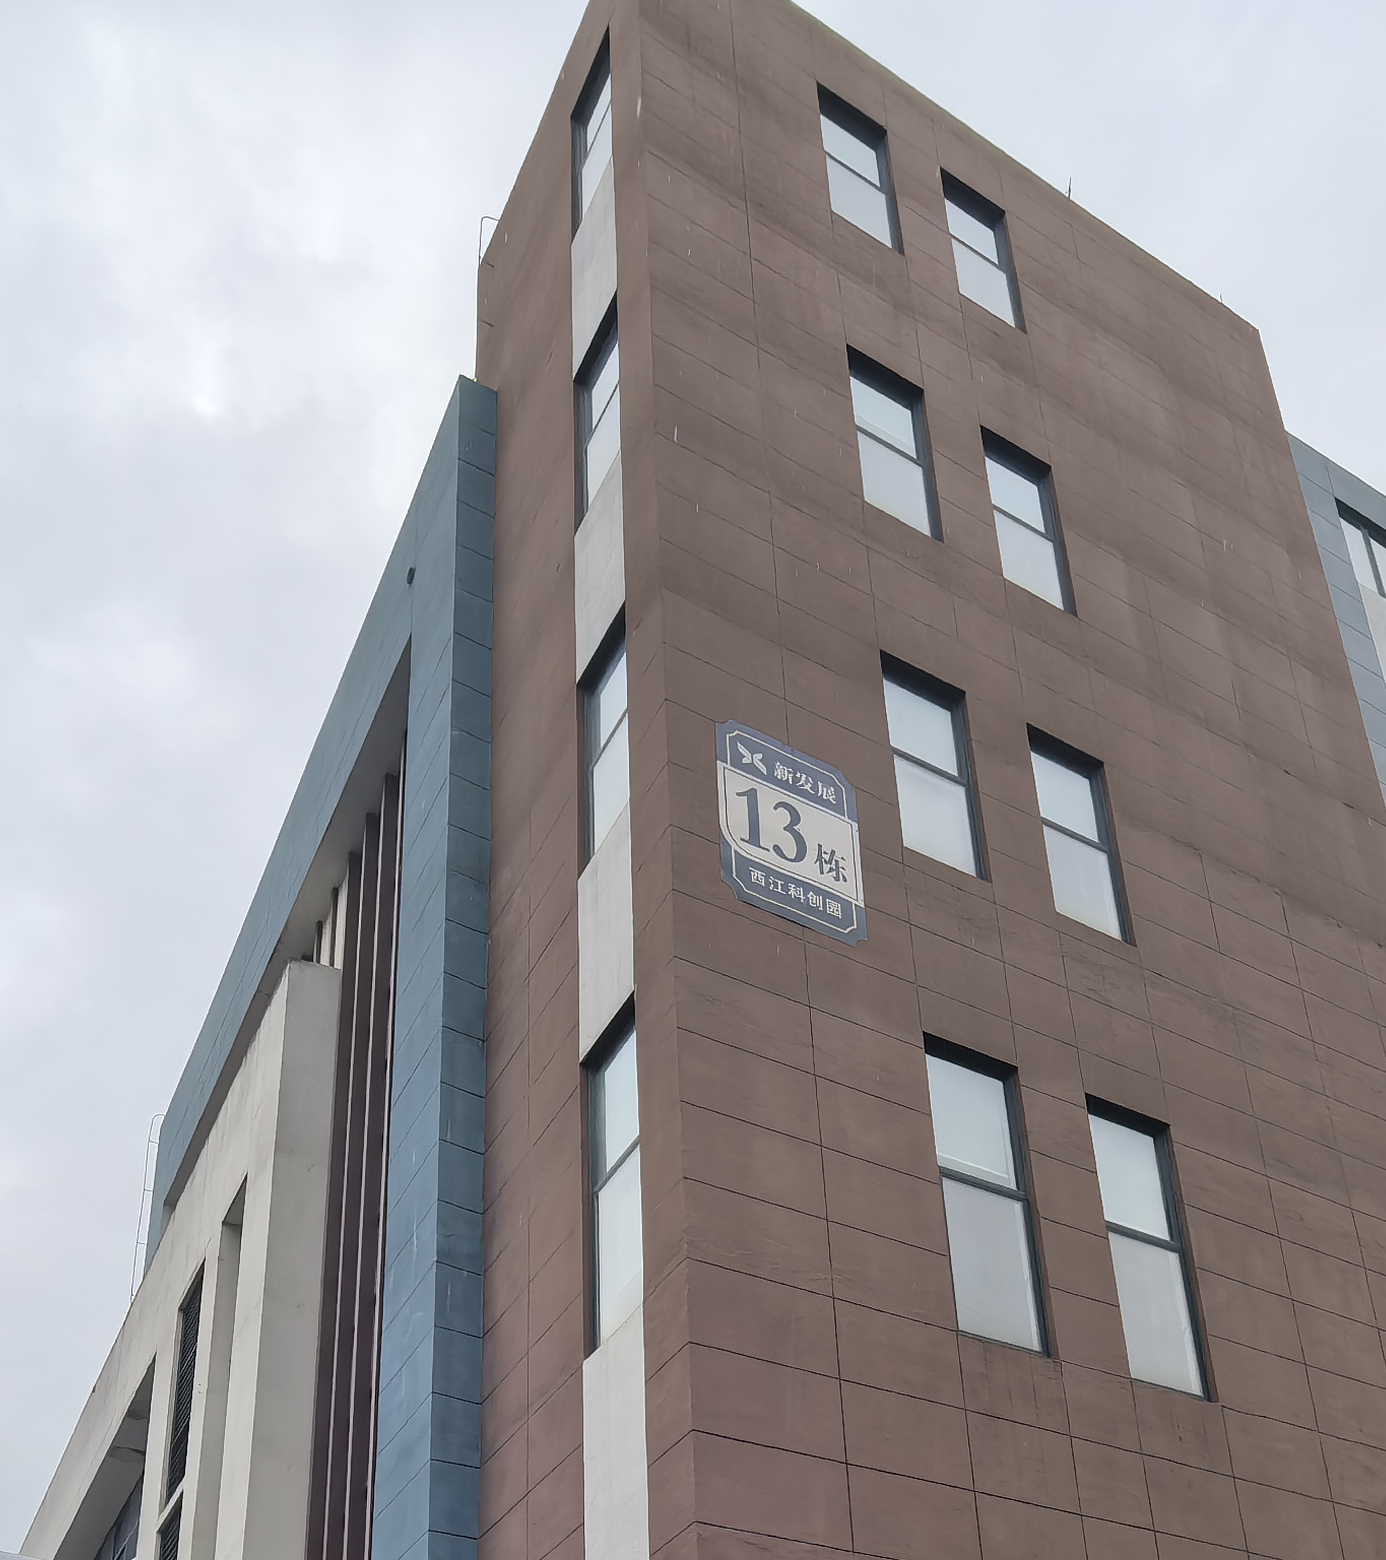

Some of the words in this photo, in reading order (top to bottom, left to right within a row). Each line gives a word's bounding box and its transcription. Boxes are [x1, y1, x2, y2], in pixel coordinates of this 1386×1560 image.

[773, 761, 837, 804] 新发展
[735, 787, 848, 884] 13栋
[748, 866, 843, 919] 西江科创园
